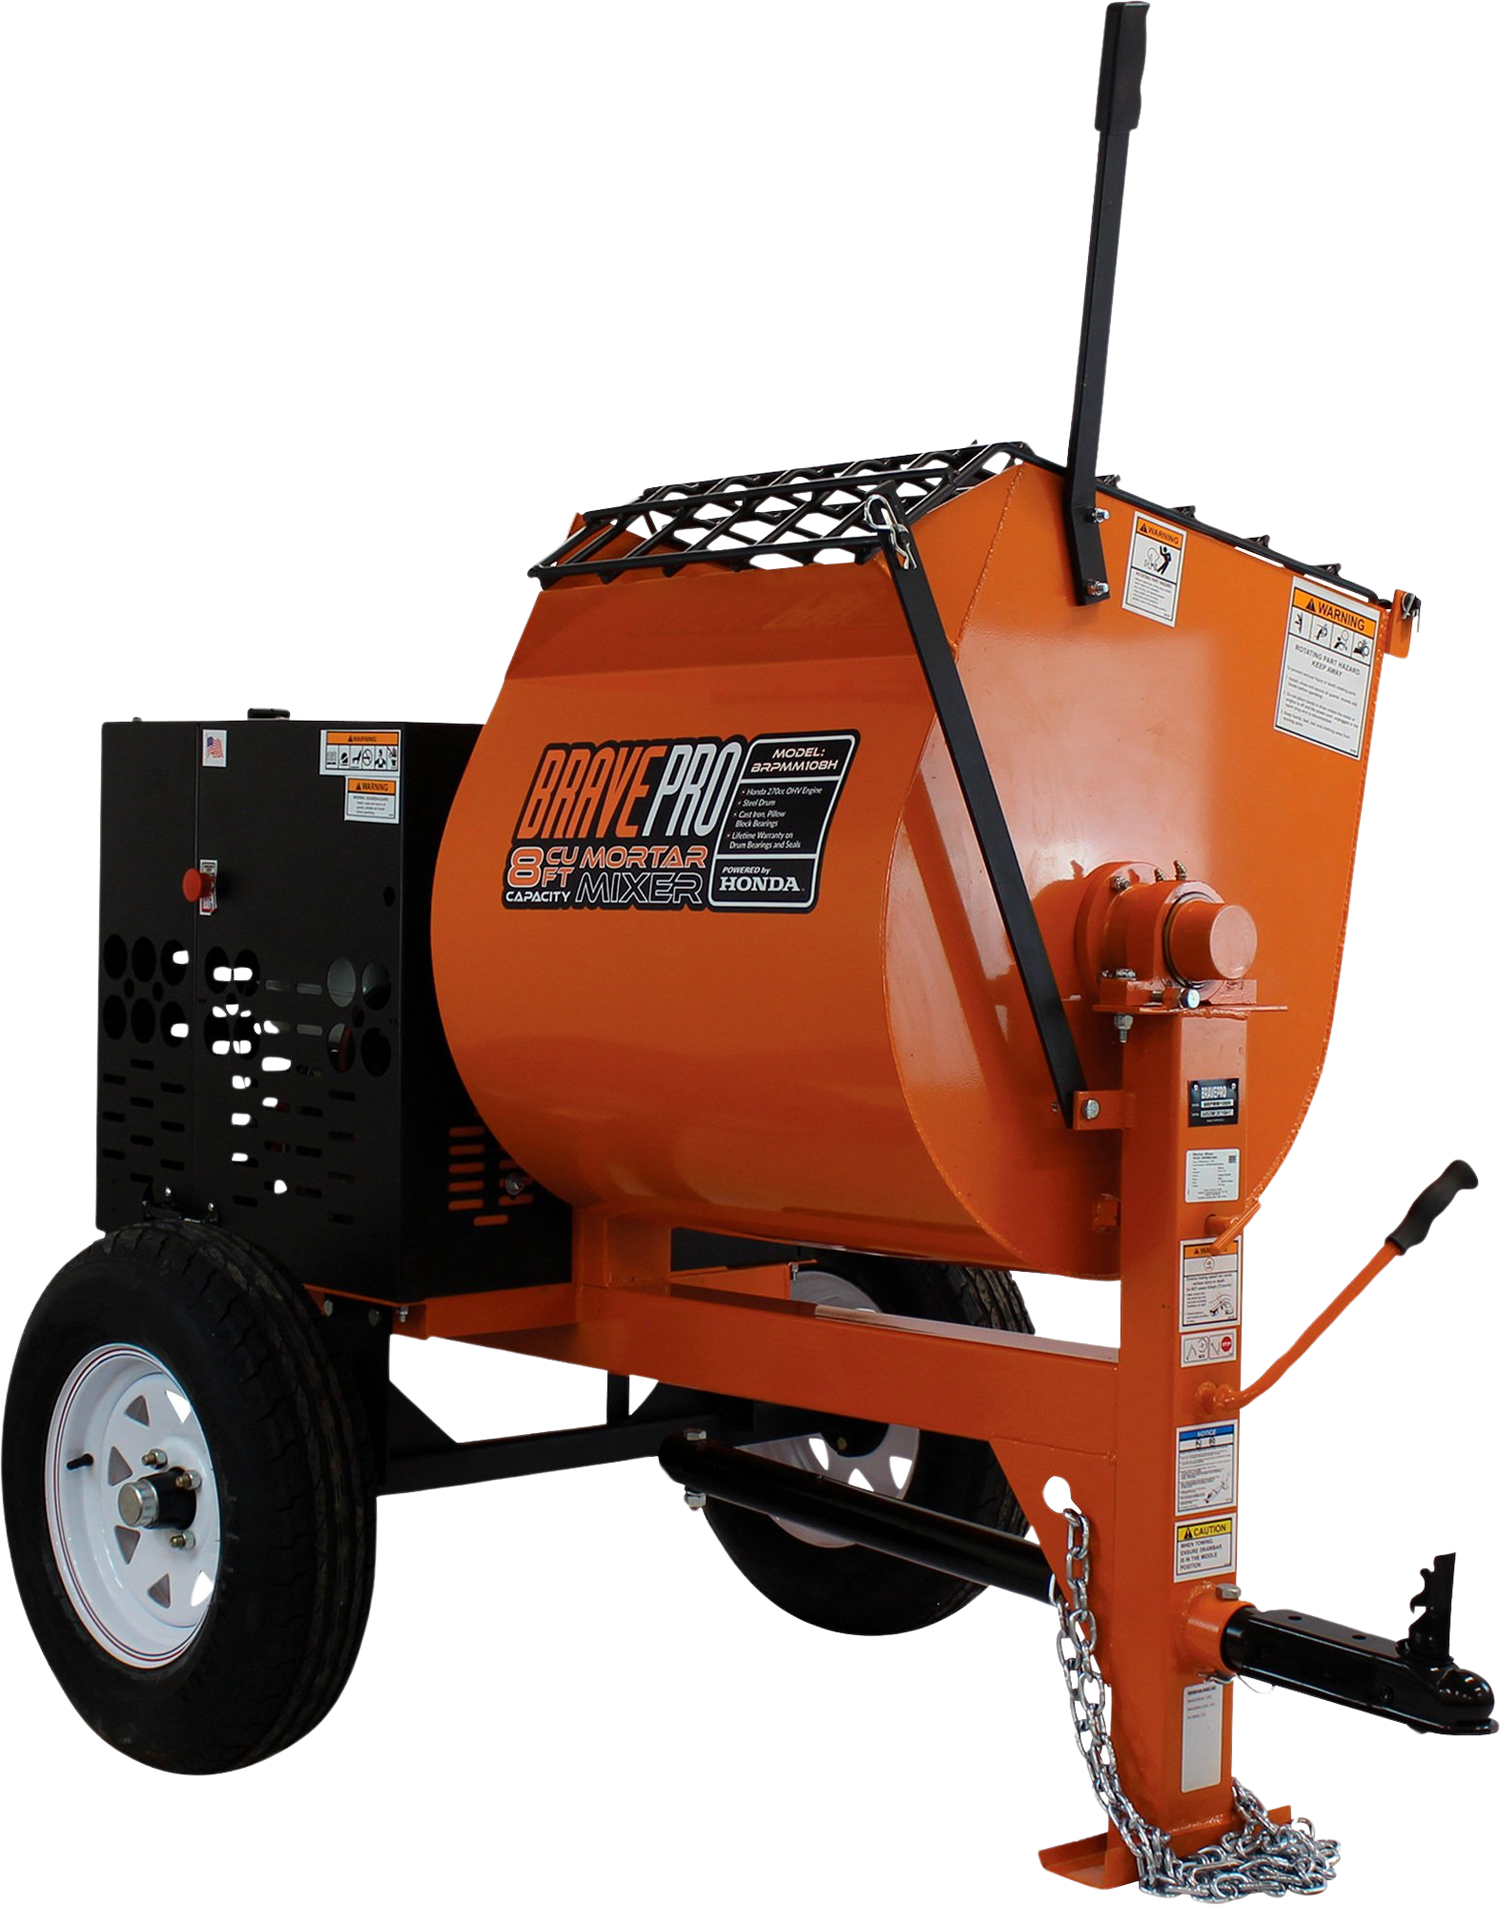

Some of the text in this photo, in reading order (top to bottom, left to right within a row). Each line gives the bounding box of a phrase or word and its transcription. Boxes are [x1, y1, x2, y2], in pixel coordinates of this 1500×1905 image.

[1147, 528, 1179, 545] WARNING
[1317, 602, 1365, 631] WARNING
[772, 747, 825, 759] MODEL:
[750, 760, 839, 773] BRPMM108H
[362, 782, 388, 791] WARNING
[746, 786, 822, 796] Honda 270cc OHV Engine
[742, 799, 758, 807] Steel
[766, 810, 786, 818] Pillow
[735, 820, 779, 829] Block Bearings
[731, 831, 756, 839] Lifetime
[757, 832, 784, 840] Warranty
[729, 841, 801, 850] Drum Bearings and Seals
[546, 846, 580, 865] CU
[579, 845, 709, 869] MORTAR
[507, 846, 545, 888] 8
[721, 866, 771, 875] POWERED by
[541, 866, 575, 888] FT
[575, 871, 704, 904] MIXER
[719, 876, 801, 892] HONDA
[505, 890, 571, 903] CAPACITY
[1197, 1429, 1217, 1437] NOTICE
[1193, 1524, 1227, 1537] CAUTION
[1180, 1541, 1194, 1549] WHEN
